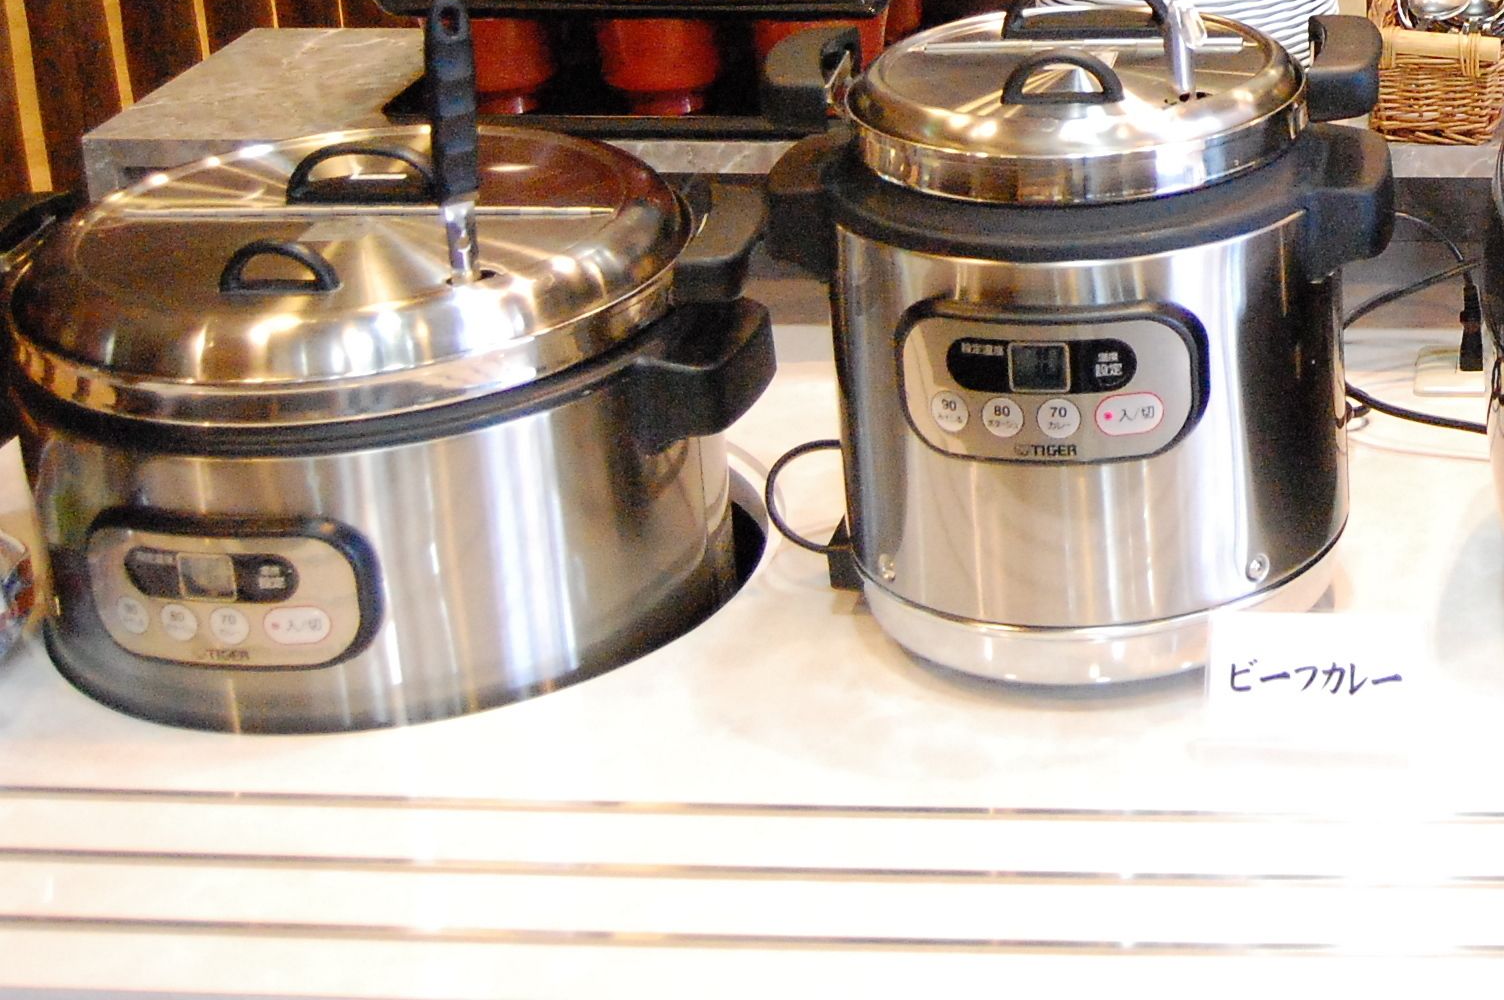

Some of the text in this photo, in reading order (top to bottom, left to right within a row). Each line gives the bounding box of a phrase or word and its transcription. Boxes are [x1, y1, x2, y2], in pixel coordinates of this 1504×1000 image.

[1050, 406, 1067, 418] 70
[1031, 444, 1077, 456] TIGER
[1230, 658, 1402, 695] ビーフカレー
